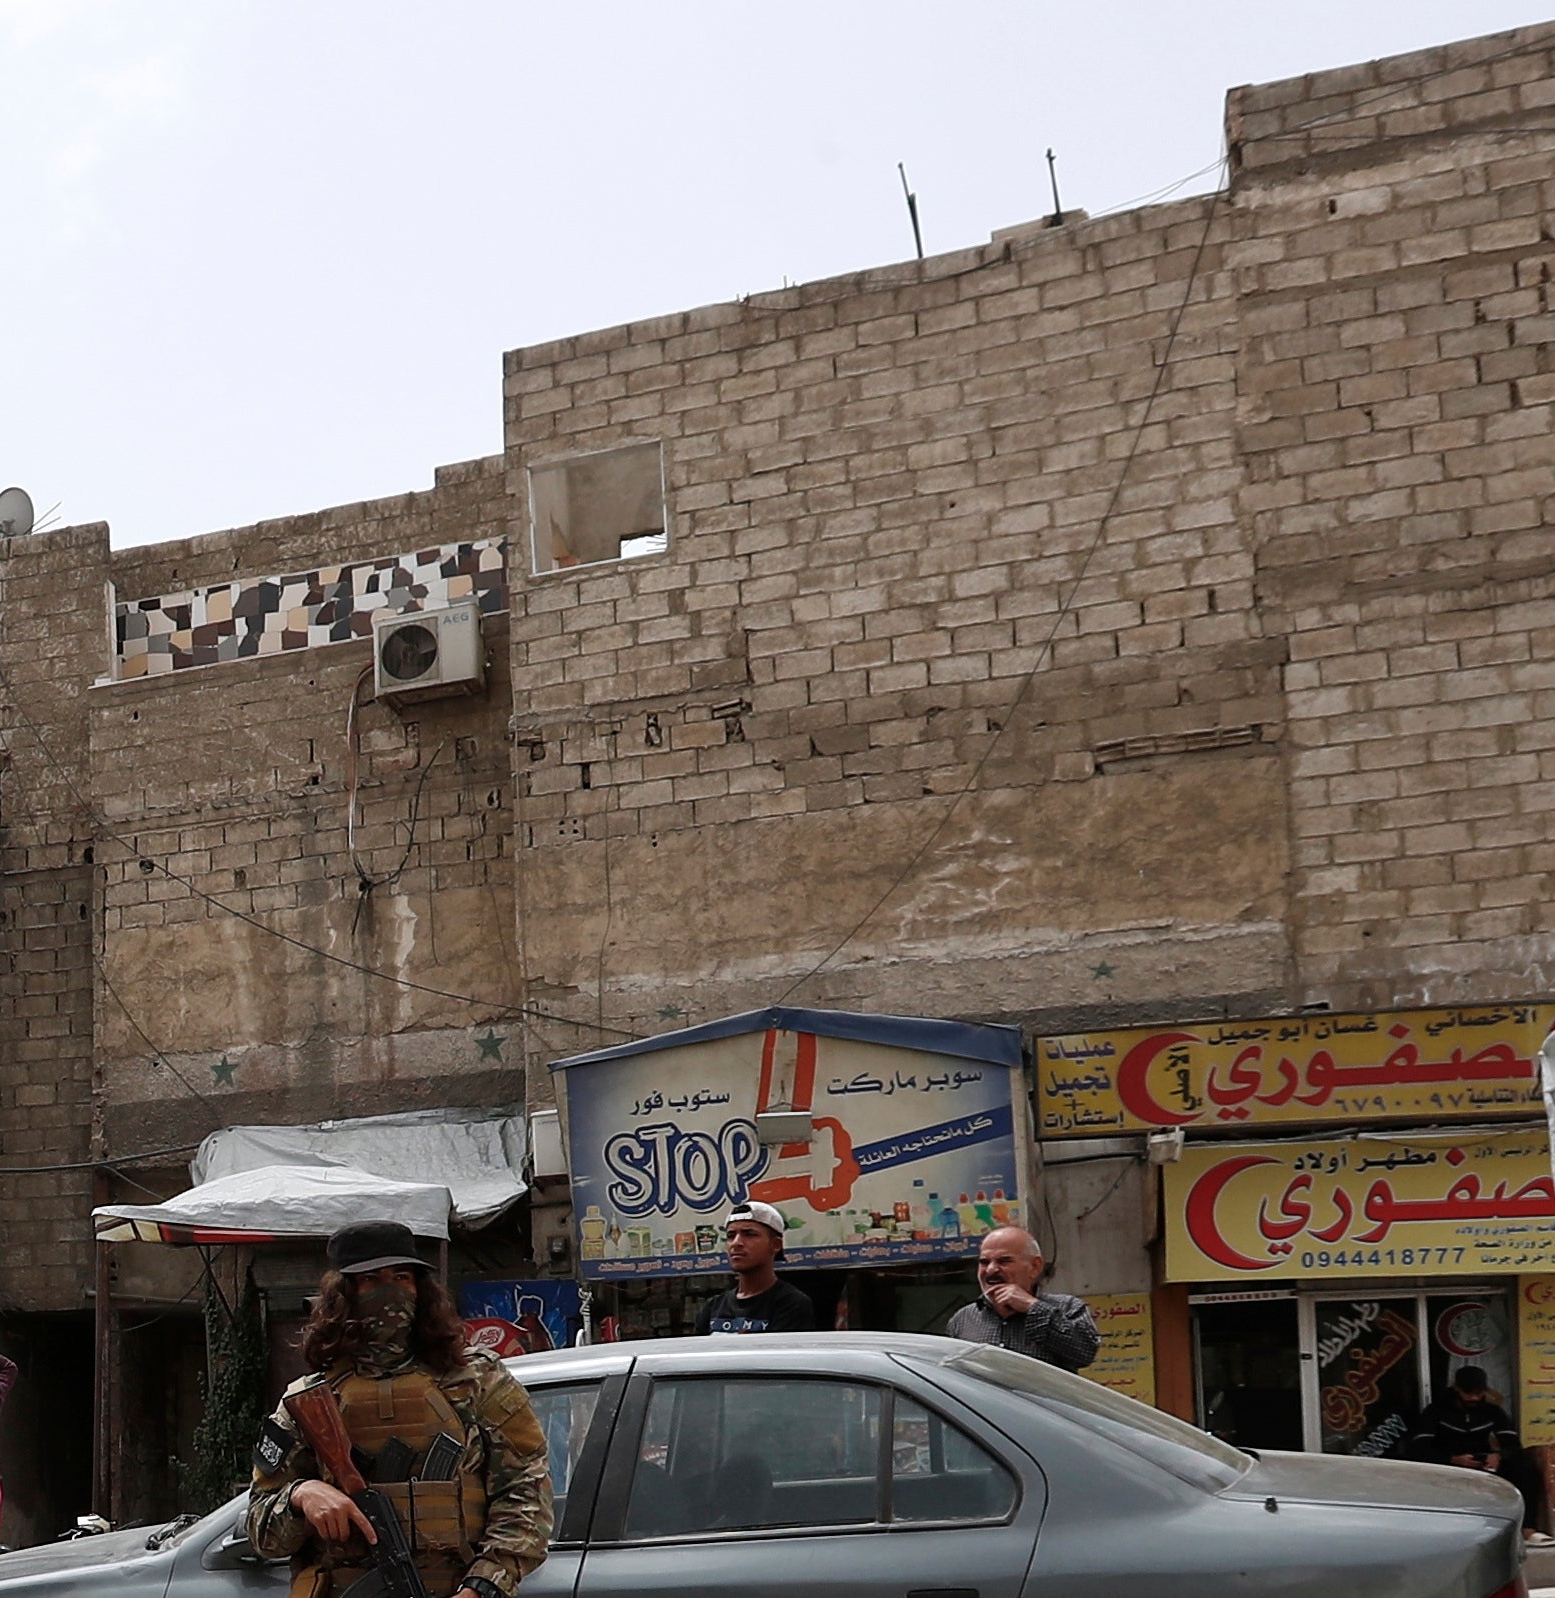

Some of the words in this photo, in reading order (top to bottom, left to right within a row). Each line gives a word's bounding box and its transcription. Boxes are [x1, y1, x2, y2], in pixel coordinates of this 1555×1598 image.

[1207, 1027, 1272, 1046] جميل
[1314, 1016, 1379, 1040] غسان
[1045, 1037, 1117, 1065] عمليات
[826, 1070, 917, 1096] ماركت
[920, 1070, 984, 1093] سوبر
[1044, 1066, 1112, 1097] تجميل
[1206, 1023, 1536, 1121] صفوري
[629, 1090, 664, 1116] فور
[668, 1089, 731, 1112] ستوب
[964, 1116, 993, 1137] كل
[604, 1118, 770, 1219] STOP
[1293, 1148, 1348, 1174] أولاد
[1354, 1148, 1438, 1173] مطهر
[1301, 1247, 1466, 1269] 0944418777
